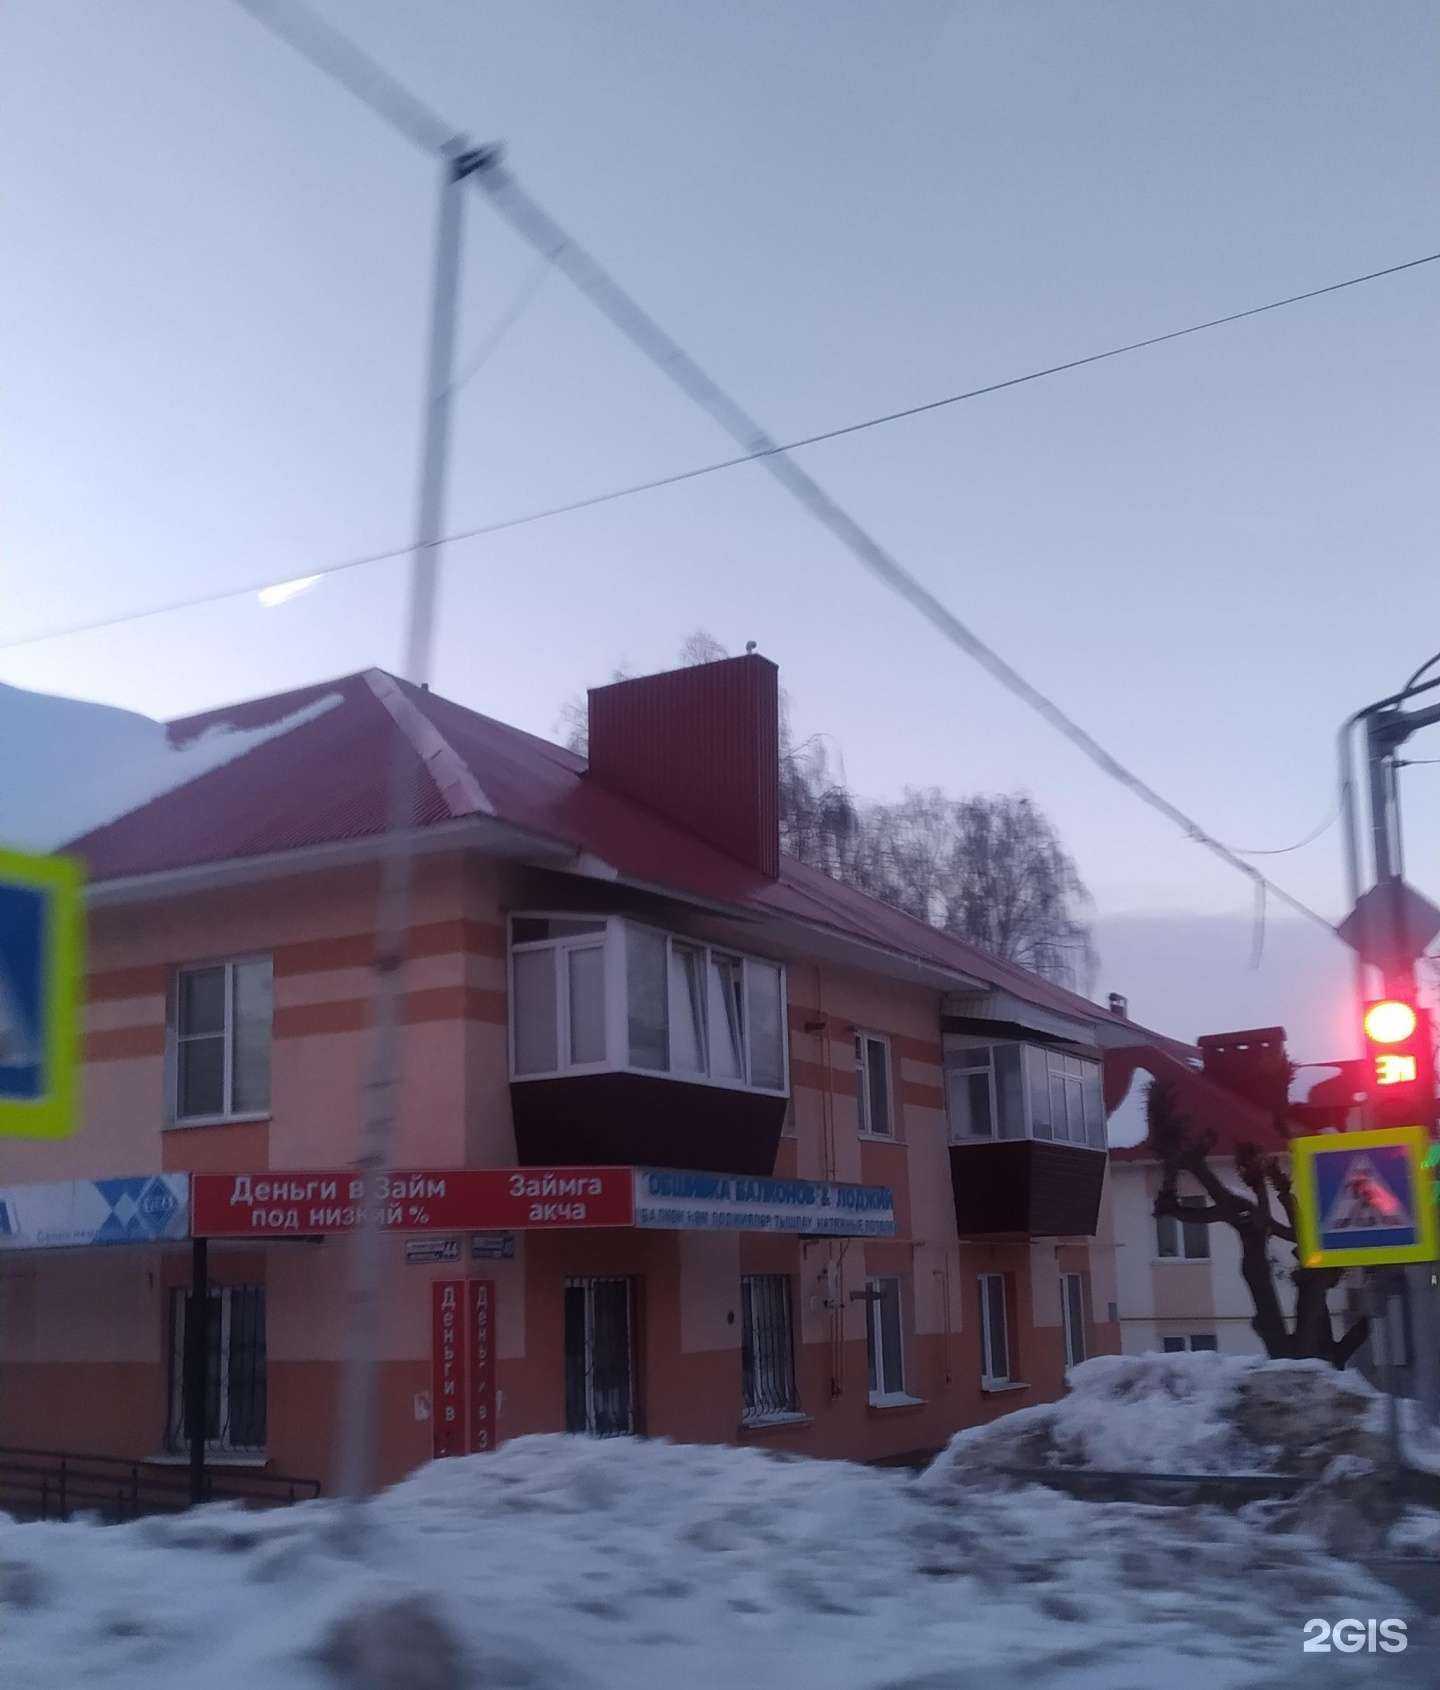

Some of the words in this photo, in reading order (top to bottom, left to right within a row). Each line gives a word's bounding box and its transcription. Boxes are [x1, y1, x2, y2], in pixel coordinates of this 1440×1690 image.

[229, 1176, 337, 1206] Деньги
[349, 1181, 364, 1200] в
[375, 1174, 446, 1200] Займ
[509, 1173, 602, 1197] Займга
[251, 1208, 299, 1230] под
[408, 1205, 430, 1224] %
[529, 1202, 587, 1221] акча
[477, 1286, 488, 1393] День
